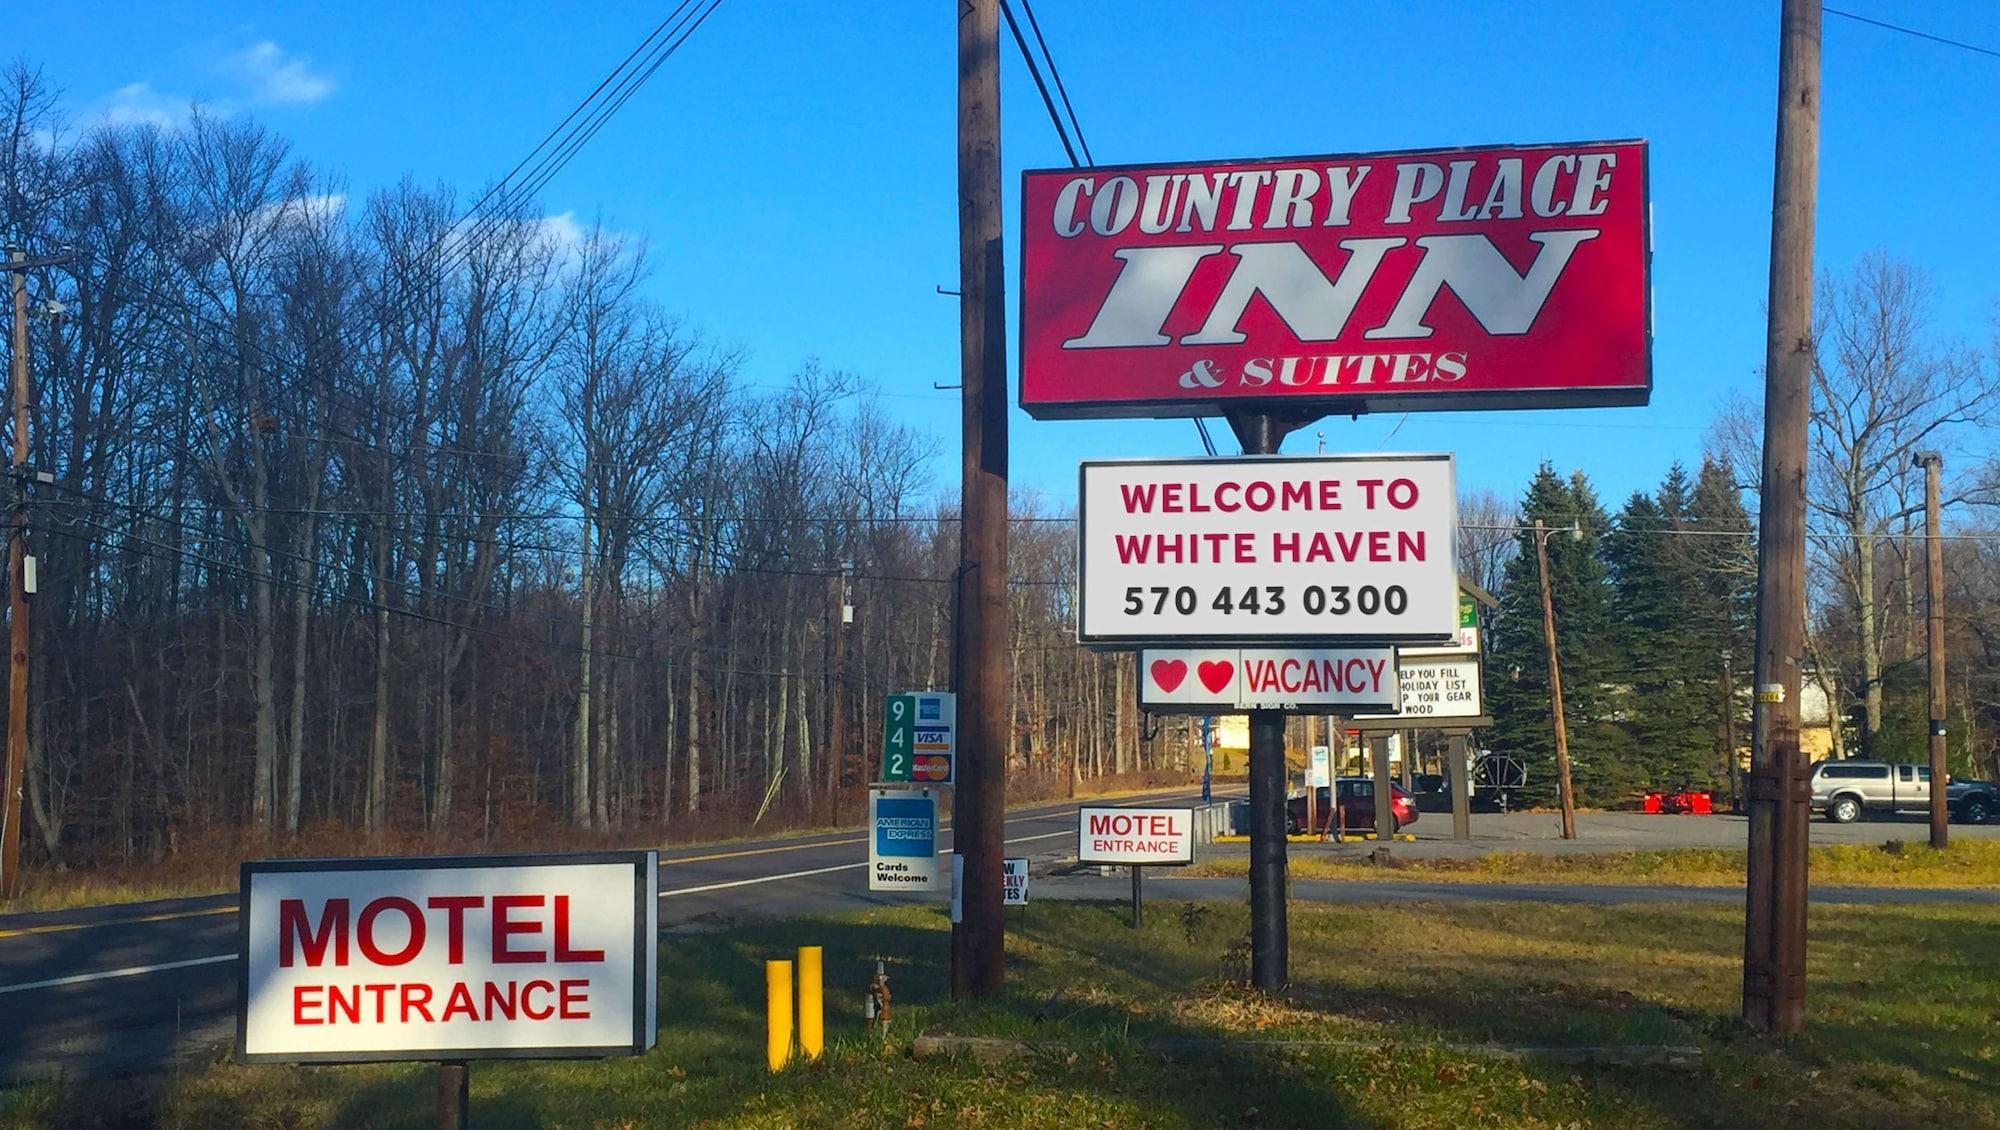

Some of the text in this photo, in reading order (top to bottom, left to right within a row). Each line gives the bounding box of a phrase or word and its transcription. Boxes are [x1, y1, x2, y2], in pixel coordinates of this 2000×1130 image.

[1053, 152, 1617, 238] COUNTRY PLACE
[1062, 228, 1601, 350] INN
[1178, 352, 1469, 390] & SUITES
[1120, 478, 1419, 514] WELCOME TO
[1115, 530, 1426, 564] WHITE HAVEN
[1123, 584, 1408, 615] 570 443 0300
[1244, 659, 1386, 694] VACANCY
[1418, 669, 1436, 679] YOU
[1440, 668, 1460, 678] FILL
[1446, 680, 1466, 690] LIST
[1418, 692, 1440, 703] YOUR
[1446, 691, 1473, 702] GEAR
[1406, 704, 1434, 715] WOOD
[917, 733, 943, 743] VISA
[876, 817, 930, 828] AMERICAN
[1090, 815, 1182, 836] MOTEL
[887, 829, 934, 840] EXPRESS
[1093, 840, 1178, 853] ENTRANCE
[876, 863, 909, 872] Cards
[877, 873, 929, 883] Welcome
[279, 895, 605, 968] MOTEL
[293, 979, 590, 1026] ENTRANCE
